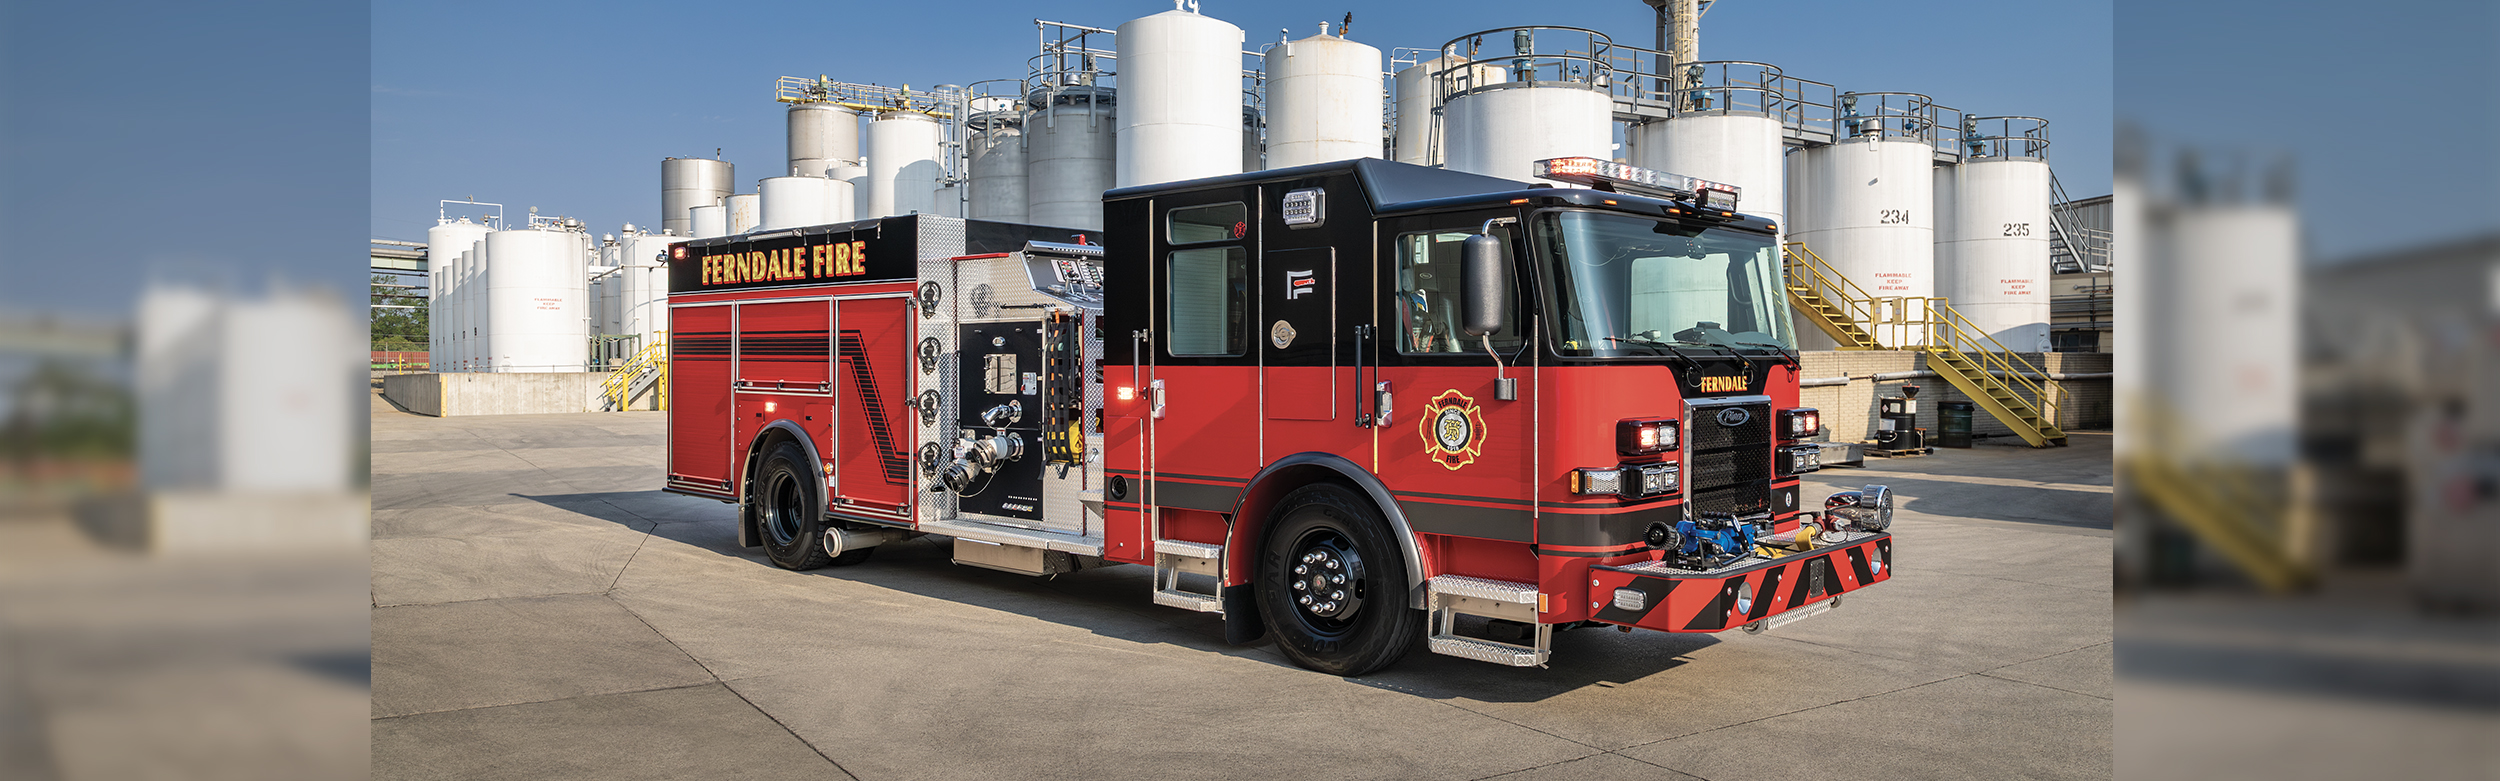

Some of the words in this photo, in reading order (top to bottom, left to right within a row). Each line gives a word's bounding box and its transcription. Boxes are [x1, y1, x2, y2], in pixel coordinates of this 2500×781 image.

[1880, 209, 1909, 225] 234
[2003, 223, 2030, 237] 235
[701, 246, 806, 286] FERNDALE
[812, 240, 866, 279] FIRE
[1701, 375, 1748, 393] FERNDALE
[1438, 397, 1468, 409] FERNDALE
[1446, 455, 1460, 464] FIRE
